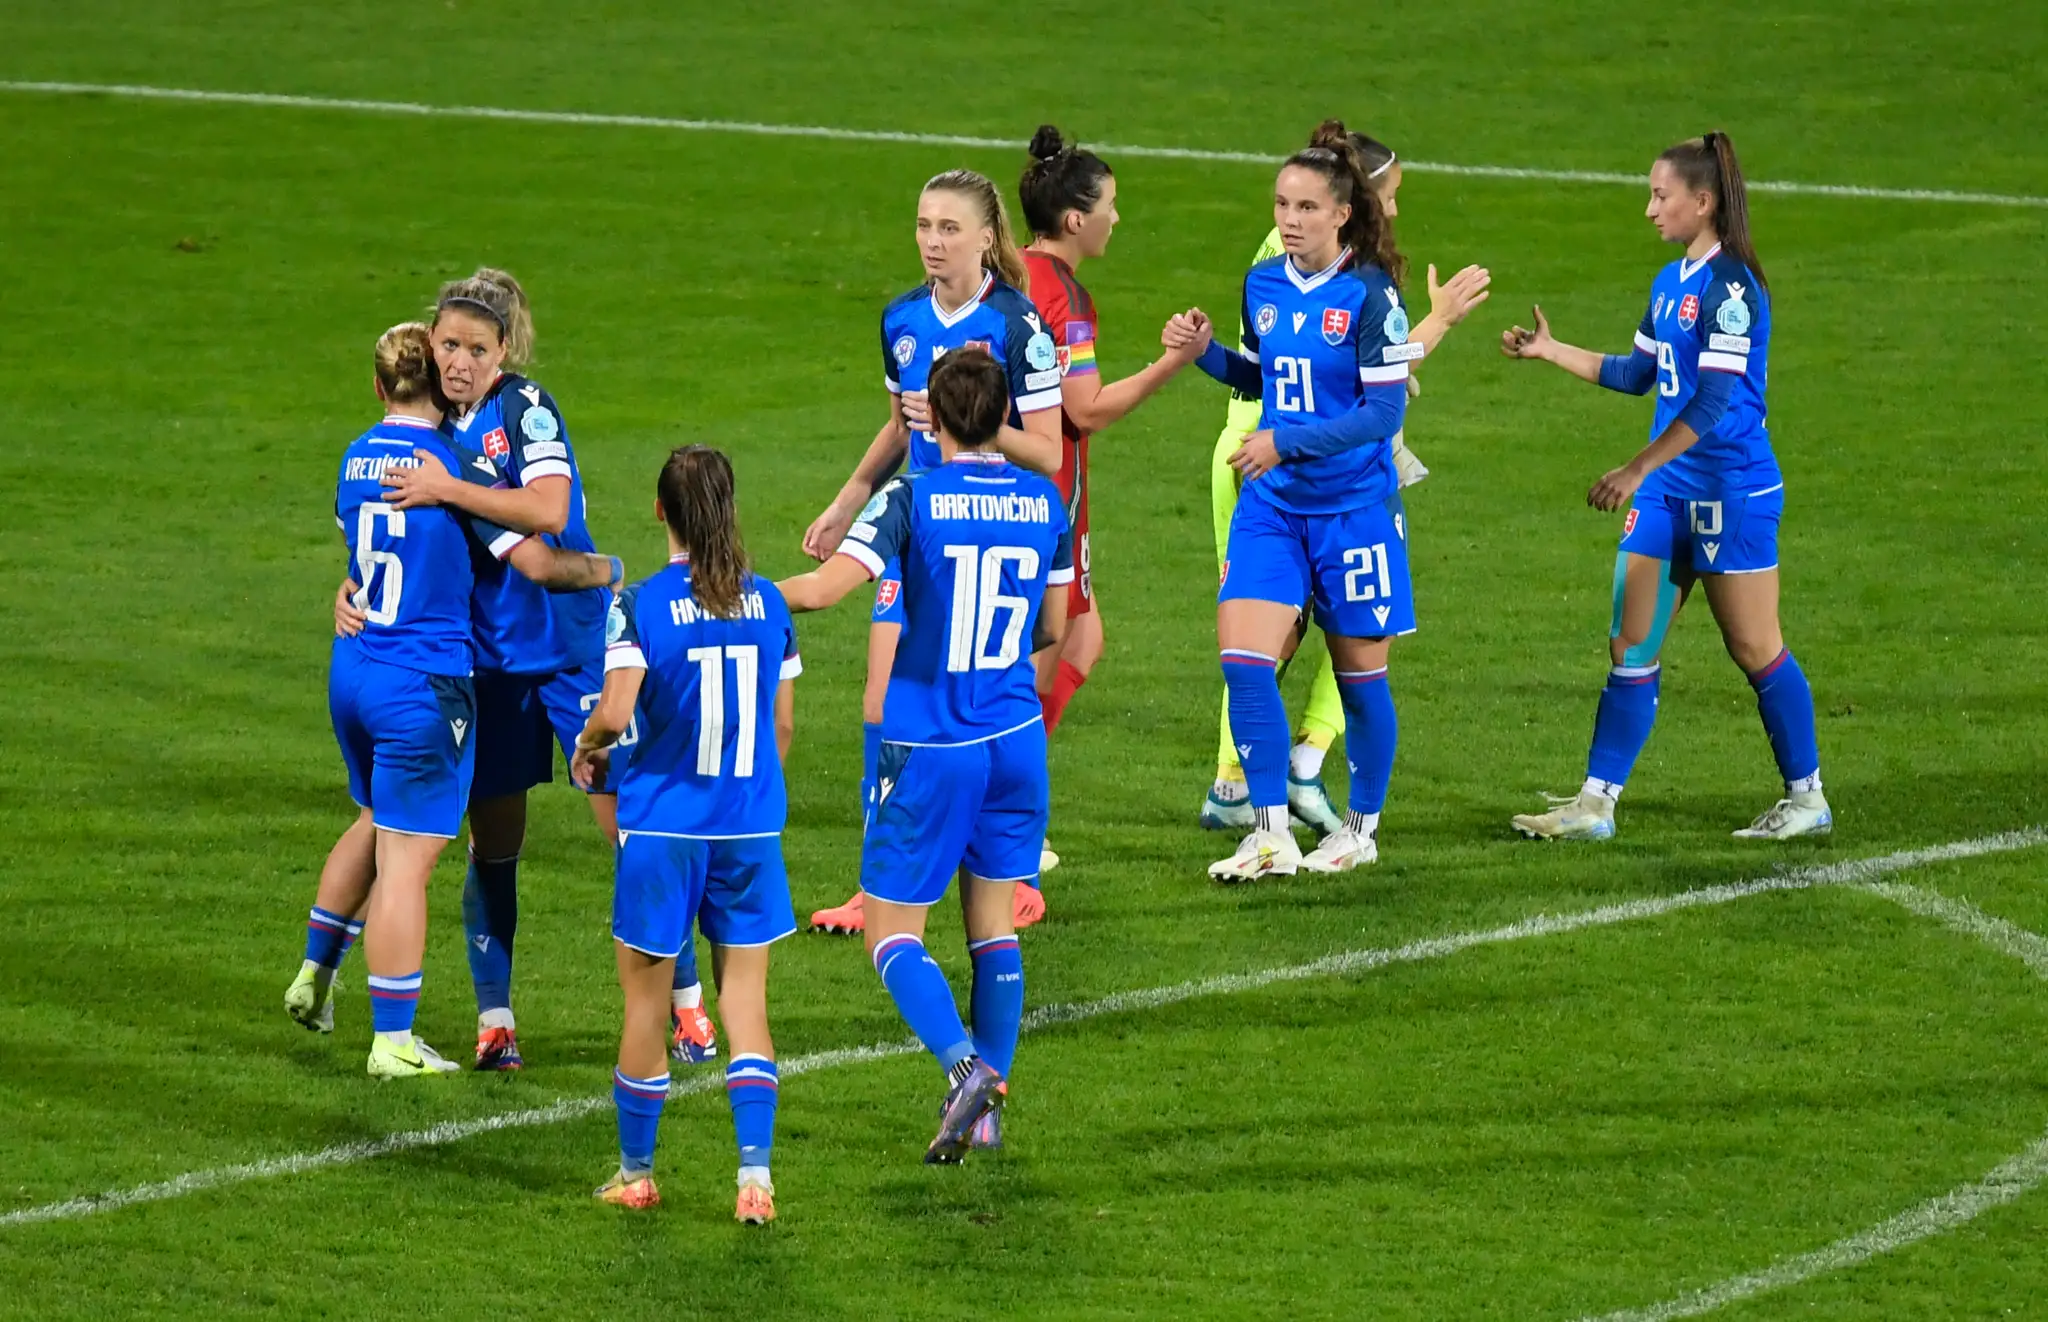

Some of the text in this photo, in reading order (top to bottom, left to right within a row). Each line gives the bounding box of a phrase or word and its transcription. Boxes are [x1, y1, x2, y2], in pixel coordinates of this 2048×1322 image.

[1273, 355, 1316, 413] 21
[930, 492, 1050, 524] BARTOVIČOVÁ
[352, 502, 406, 626] 6
[944, 545, 1039, 673] 16
[1343, 542, 1392, 602] 21
[688, 645, 758, 777] 11
